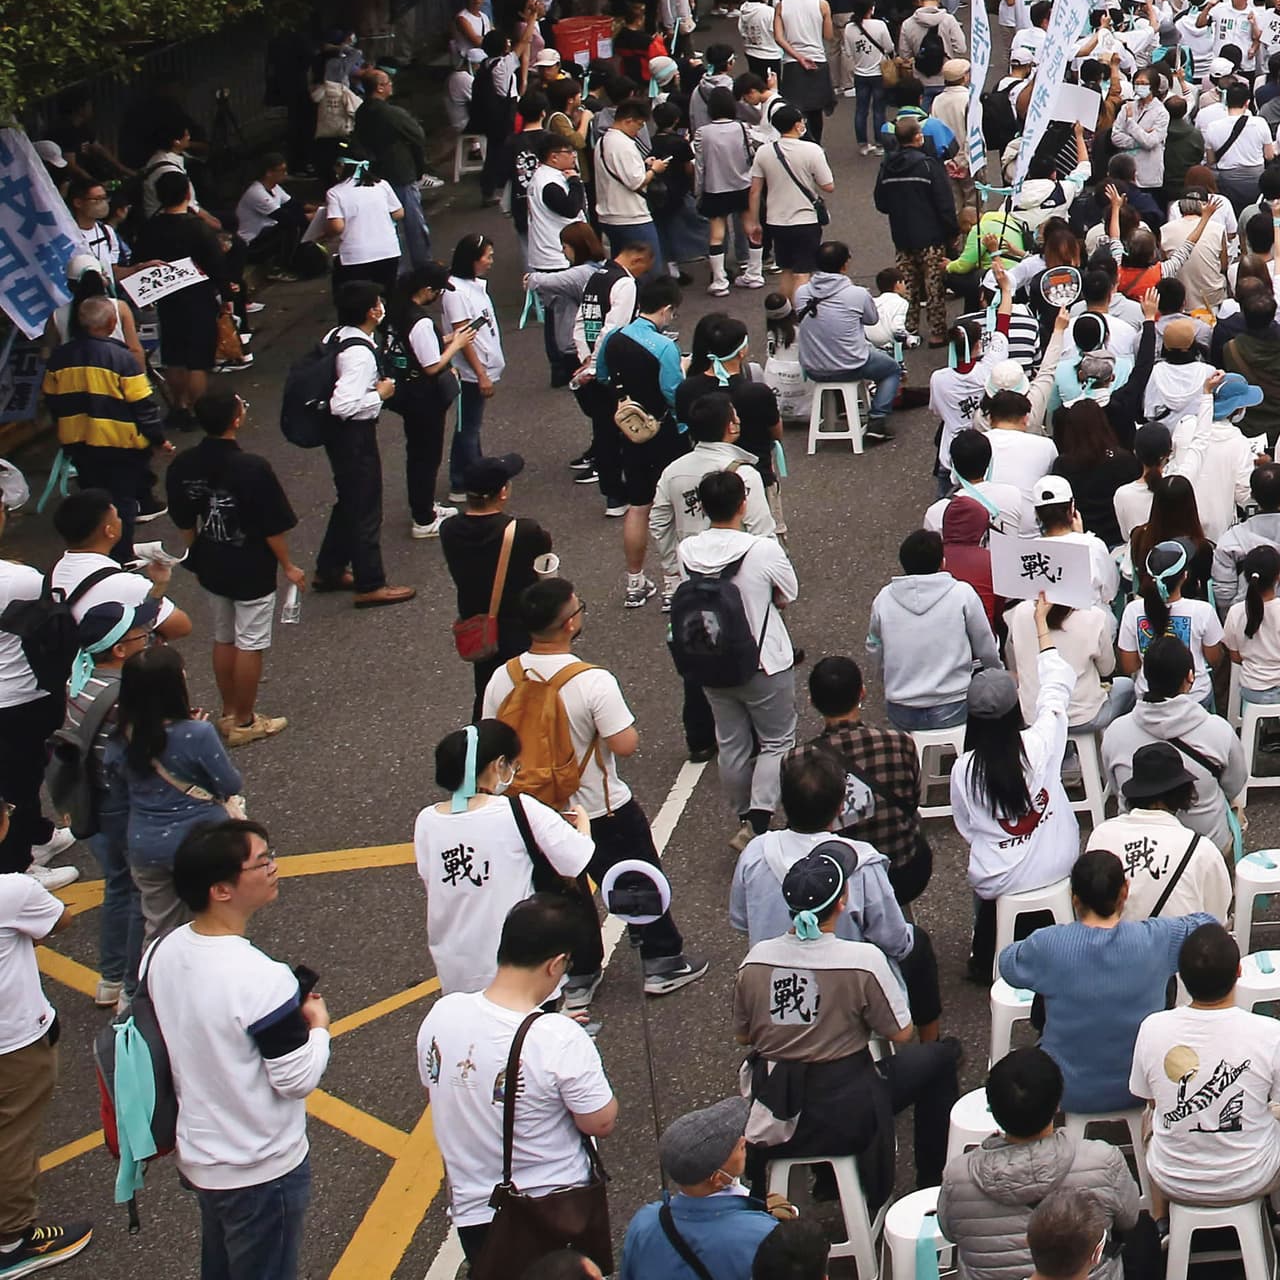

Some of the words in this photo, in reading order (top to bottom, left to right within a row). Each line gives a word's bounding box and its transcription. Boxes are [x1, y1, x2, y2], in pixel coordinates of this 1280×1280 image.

[1020, 551, 1063, 584] 戰!
[441, 843, 490, 888] 戰!
[1123, 836, 1169, 880] 戰!
[770, 972, 821, 1023] 戰!
